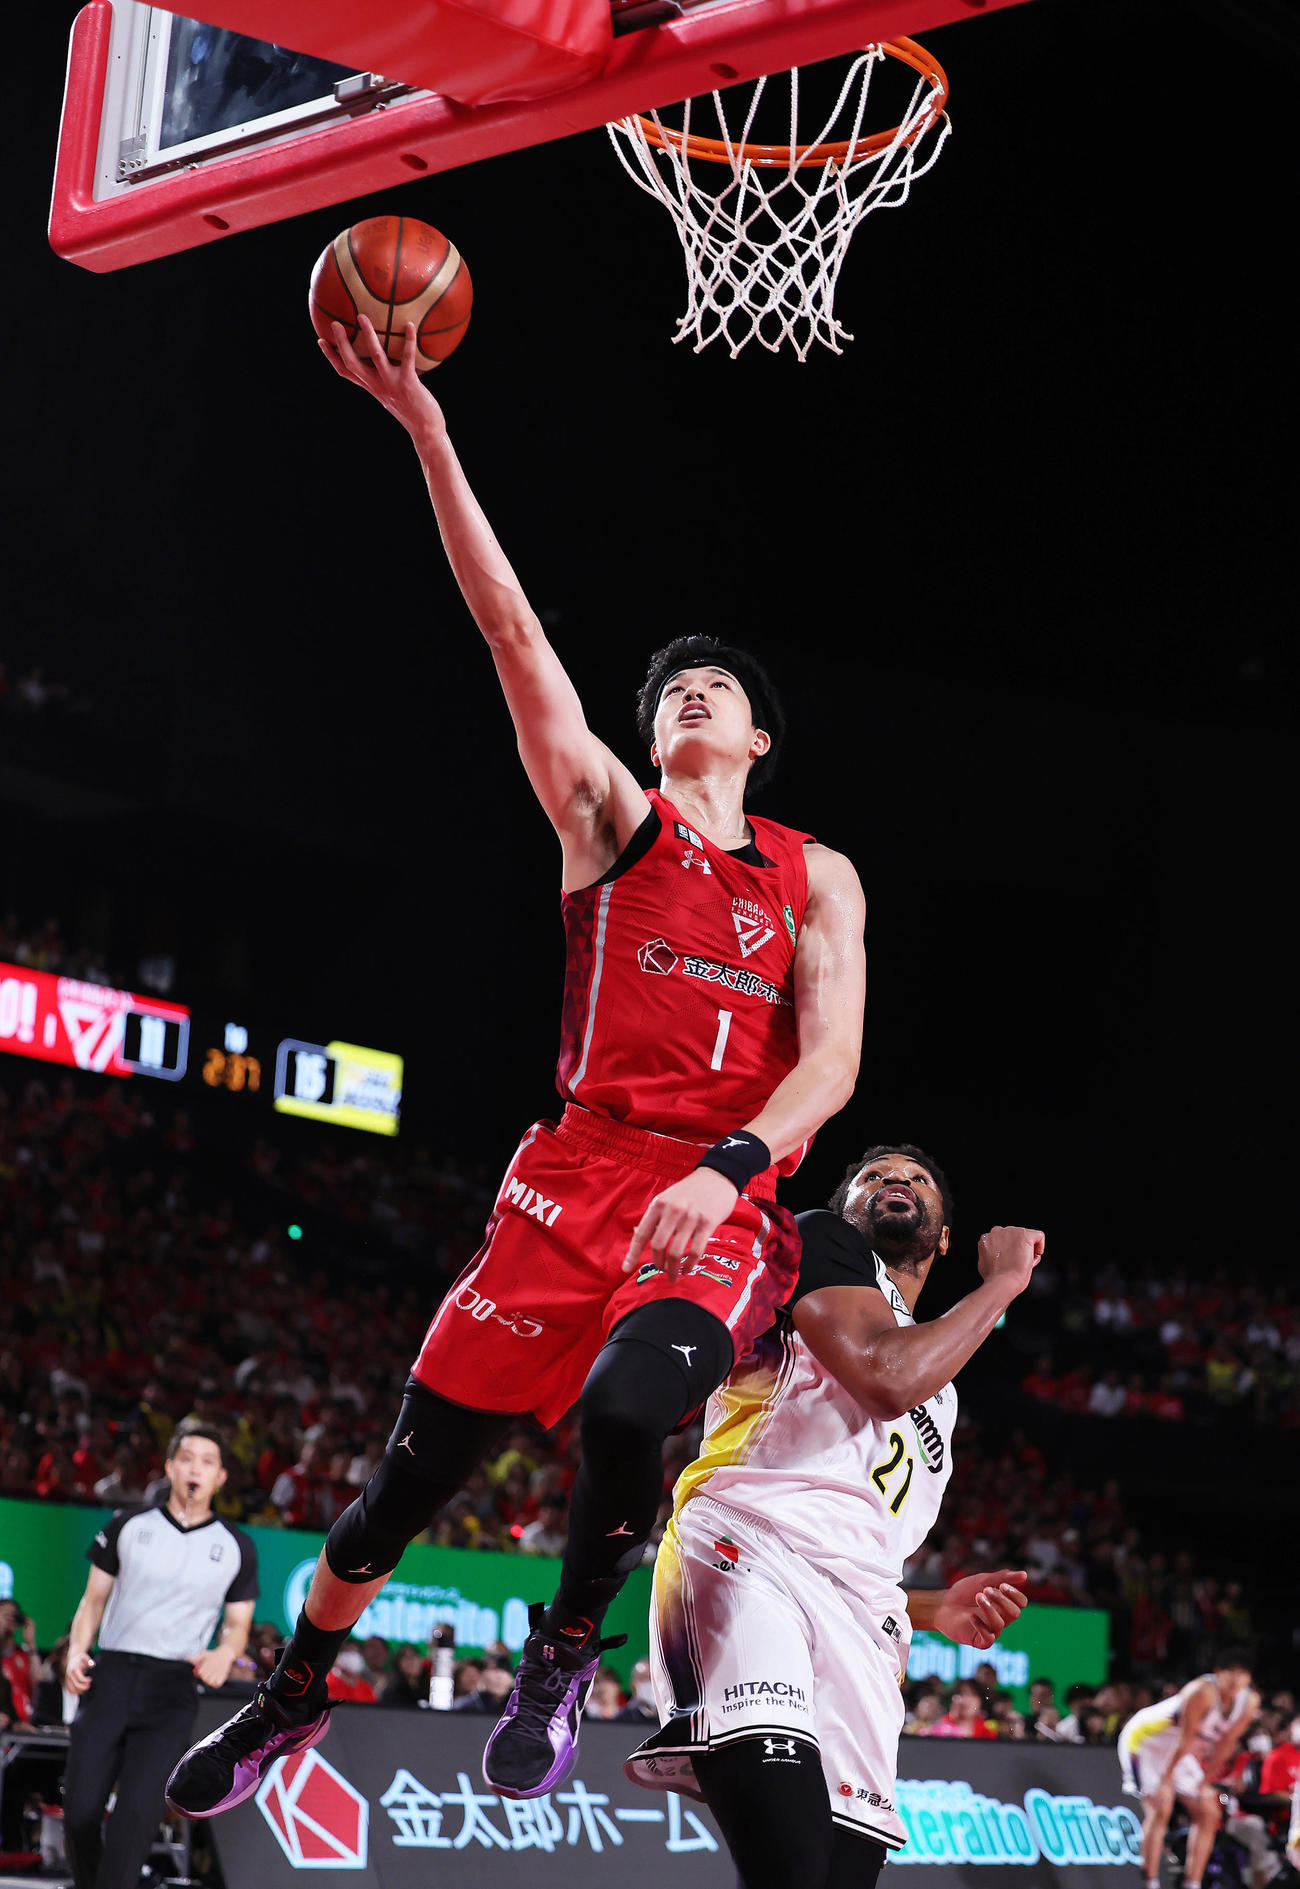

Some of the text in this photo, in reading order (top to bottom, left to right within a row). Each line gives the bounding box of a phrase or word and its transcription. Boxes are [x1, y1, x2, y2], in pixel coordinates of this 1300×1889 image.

[710, 1008, 733, 1071] 1
[504, 1176, 563, 1227] MIXI
[870, 1430, 913, 1517] 21
[721, 1698, 761, 1714] Inspire
[766, 1697, 785, 1706] the
[724, 1681, 805, 1702] HITACHI
[379, 1768, 719, 1853] 金太郎ホーム
